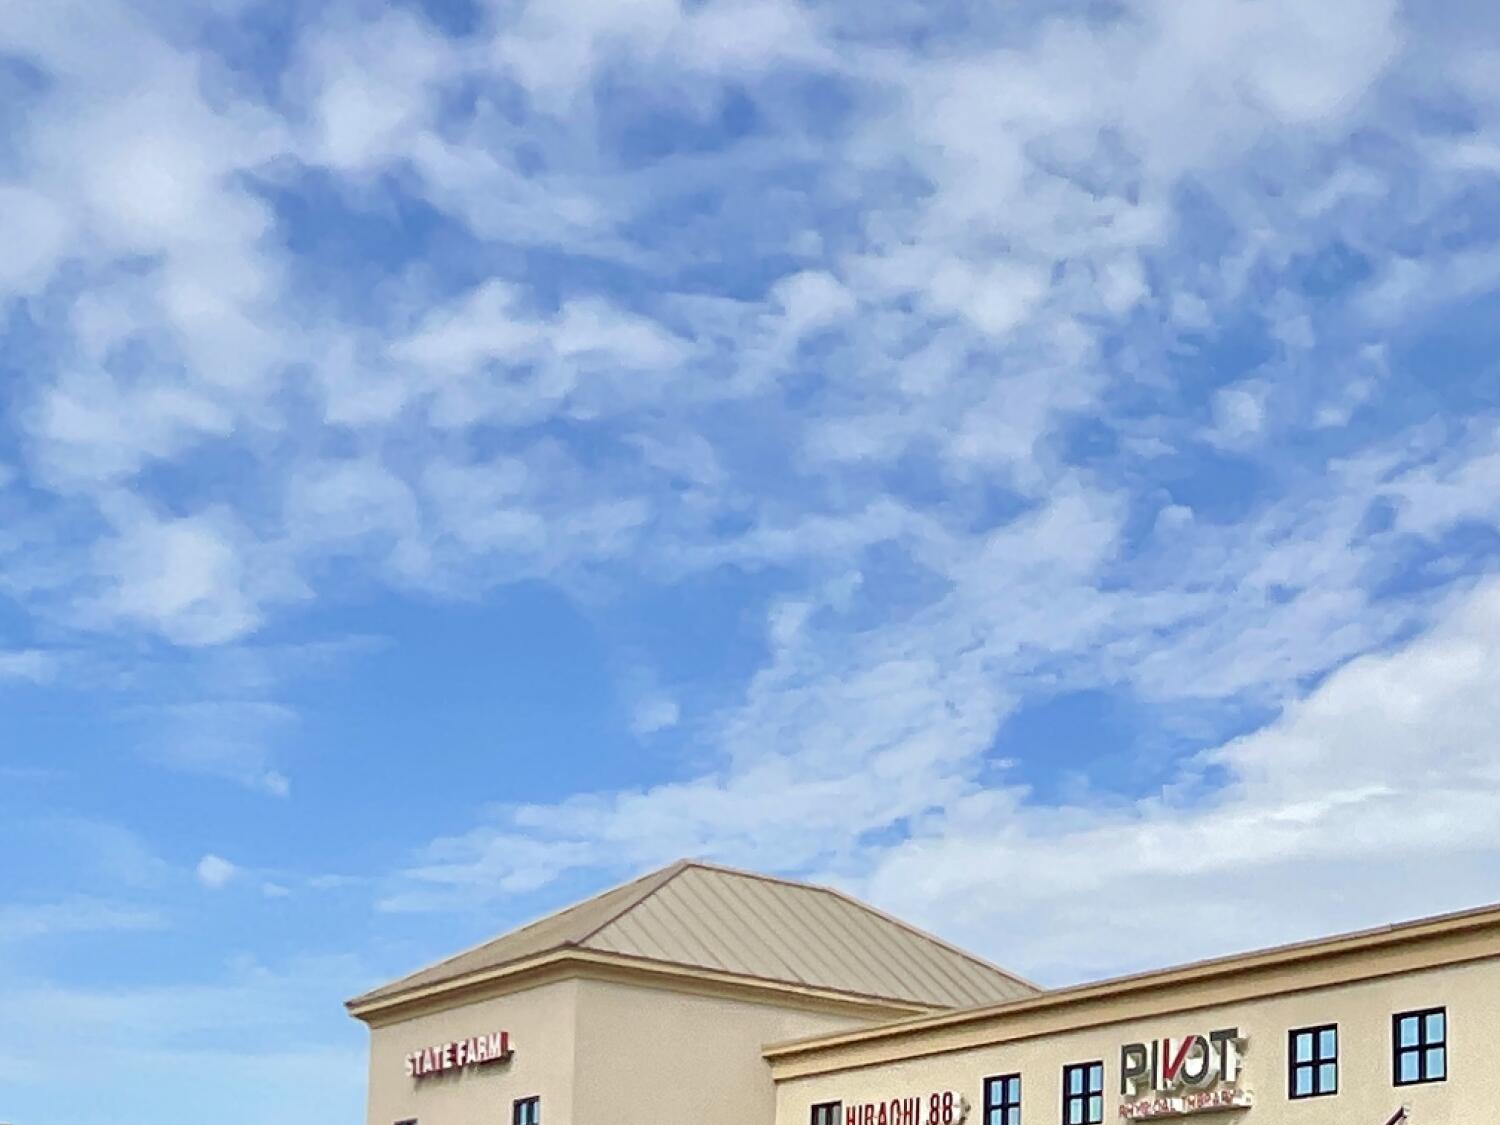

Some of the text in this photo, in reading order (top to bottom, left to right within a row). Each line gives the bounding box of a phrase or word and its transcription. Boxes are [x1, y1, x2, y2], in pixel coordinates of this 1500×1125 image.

[405, 1031, 502, 1077] STATE FARM
[1120, 1027, 1238, 1095] PIVOT
[929, 1091, 953, 1125] 88
